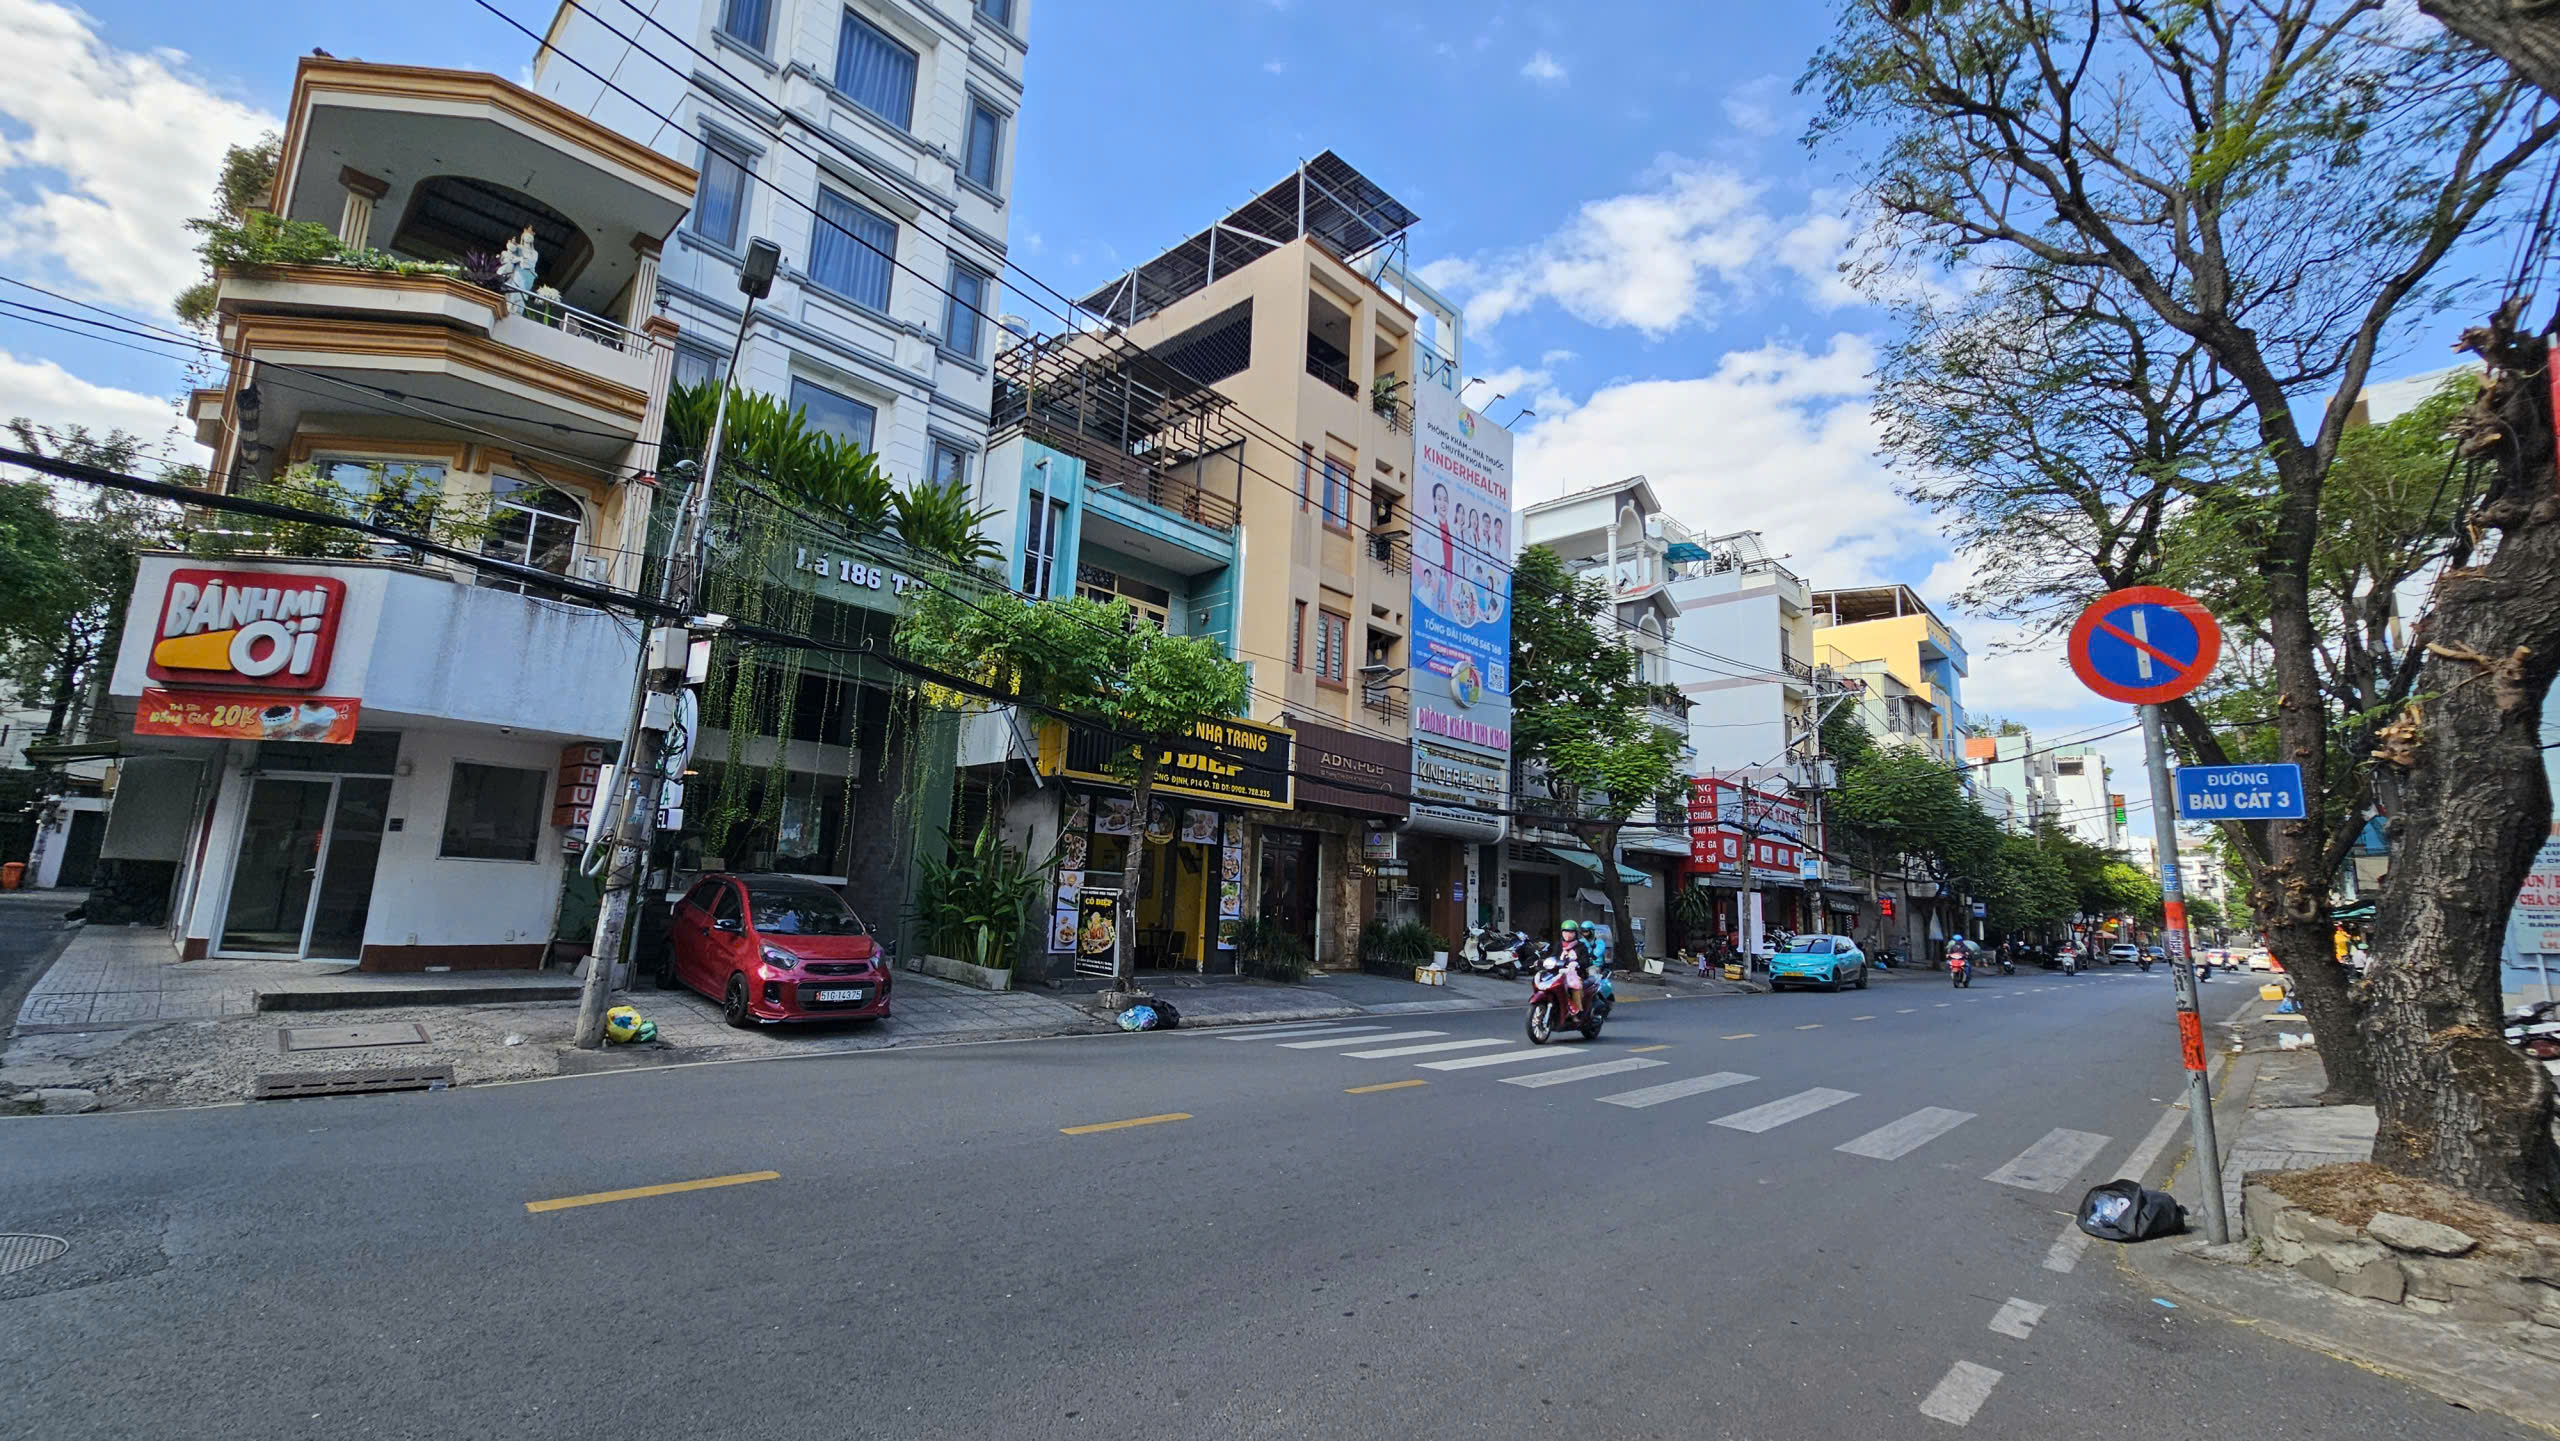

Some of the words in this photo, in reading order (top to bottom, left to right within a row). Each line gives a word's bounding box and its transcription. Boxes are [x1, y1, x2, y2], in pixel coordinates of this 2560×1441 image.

[1427, 422, 1450, 440] PHÒNG
[1424, 444, 1506, 501] KINDERHEALTH
[1465, 455, 1481, 468] KHOA
[840, 561, 881, 589] 186
[163, 578, 281, 638] BÁNH
[1424, 618, 1445, 635] TỔNG
[210, 705, 258, 729] 20K
[1416, 705, 1447, 736] PHÒNG
[1447, 714, 1473, 743] KHÁM
[1196, 721, 1223, 743] NHA
[1226, 728, 1268, 752] TRANG
[1418, 761, 1500, 796] KINDERHEALTH
[2207, 770, 2269, 786] ĐƯỜNG
[1698, 795, 1713, 804] GA
[2189, 789, 2227, 810] BÀU
[2234, 787, 2272, 809] CÁT
[2277, 791, 2290, 808] 3
[1696, 840, 1706, 849] XE
[1707, 840, 1717, 849] GA
[1694, 855, 1704, 863] XE
